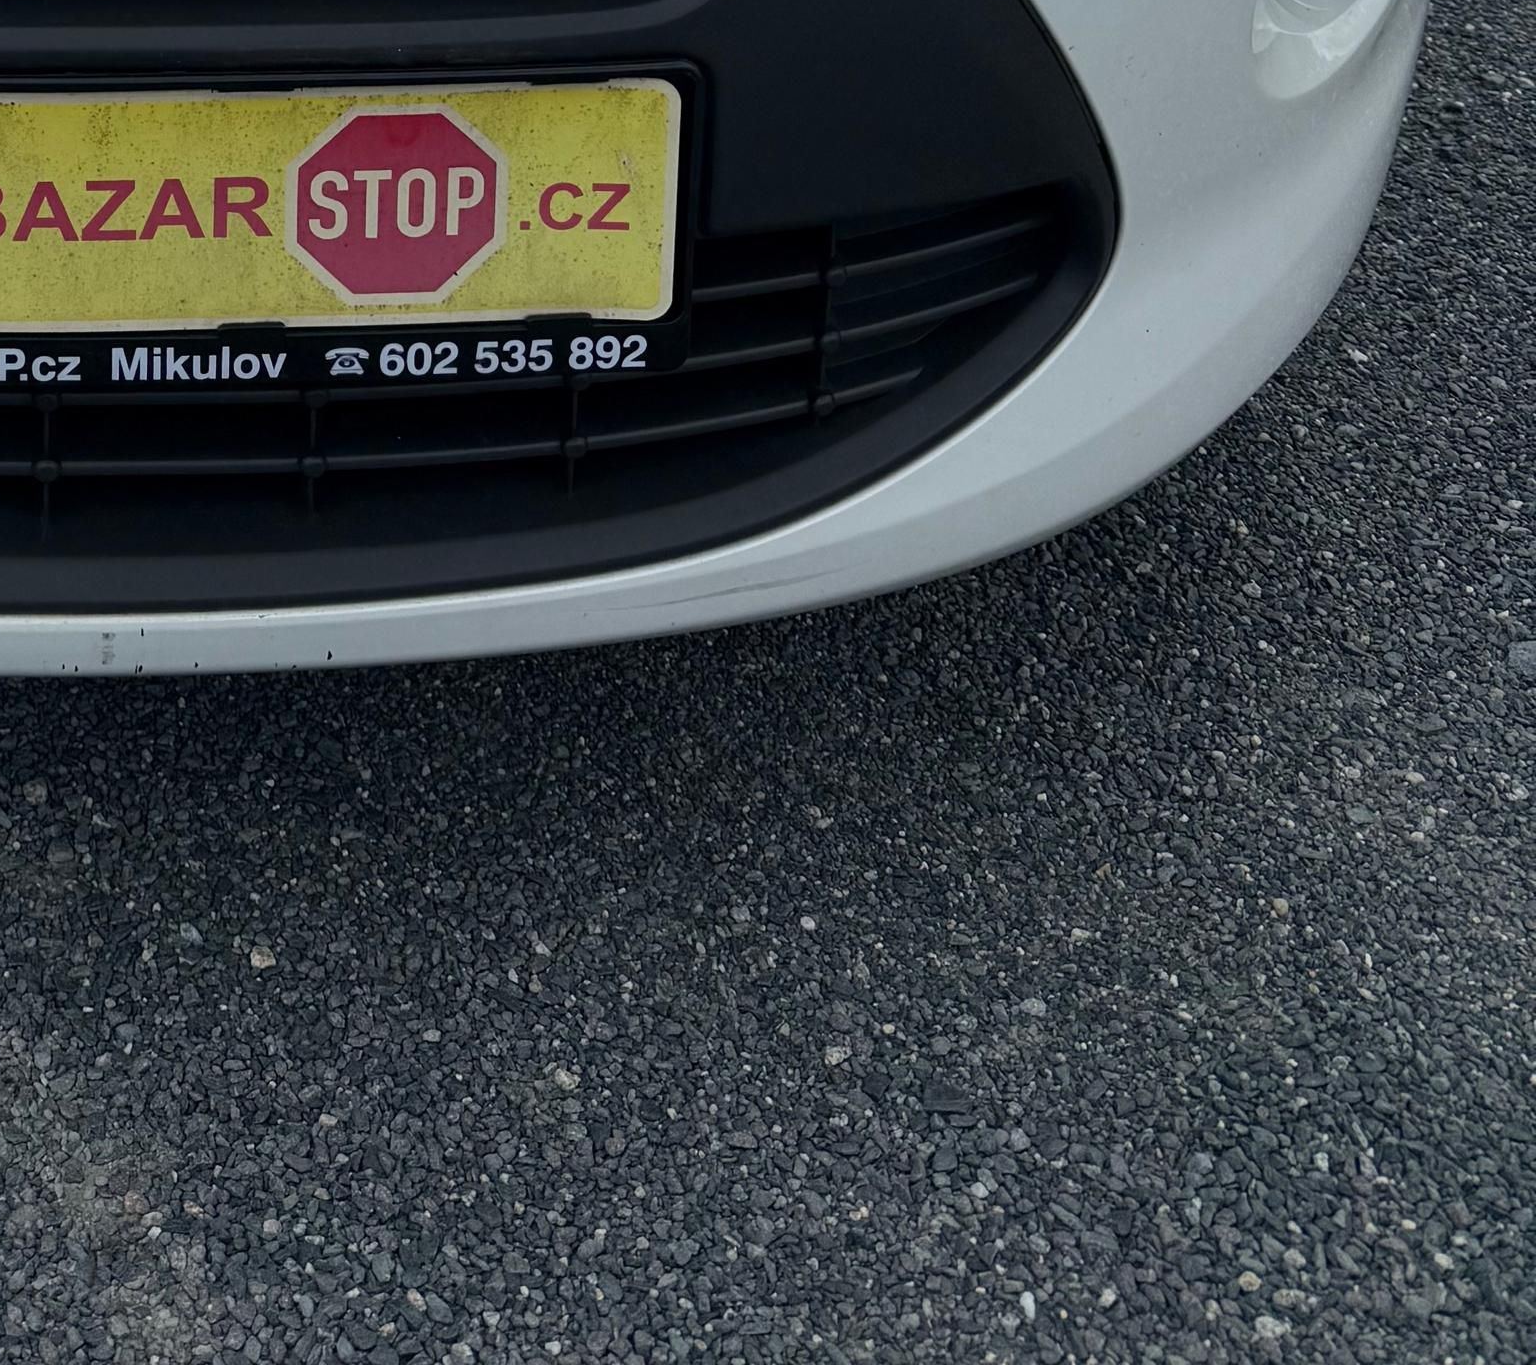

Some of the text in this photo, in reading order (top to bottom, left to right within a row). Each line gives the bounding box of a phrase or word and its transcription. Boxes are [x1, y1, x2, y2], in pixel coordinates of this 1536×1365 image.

[308, 167, 486, 240] STOP
[111, 345, 287, 382] Mikulov
[379, 342, 460, 377] 602
[474, 339, 554, 373] 535
[568, 335, 648, 370] 892
